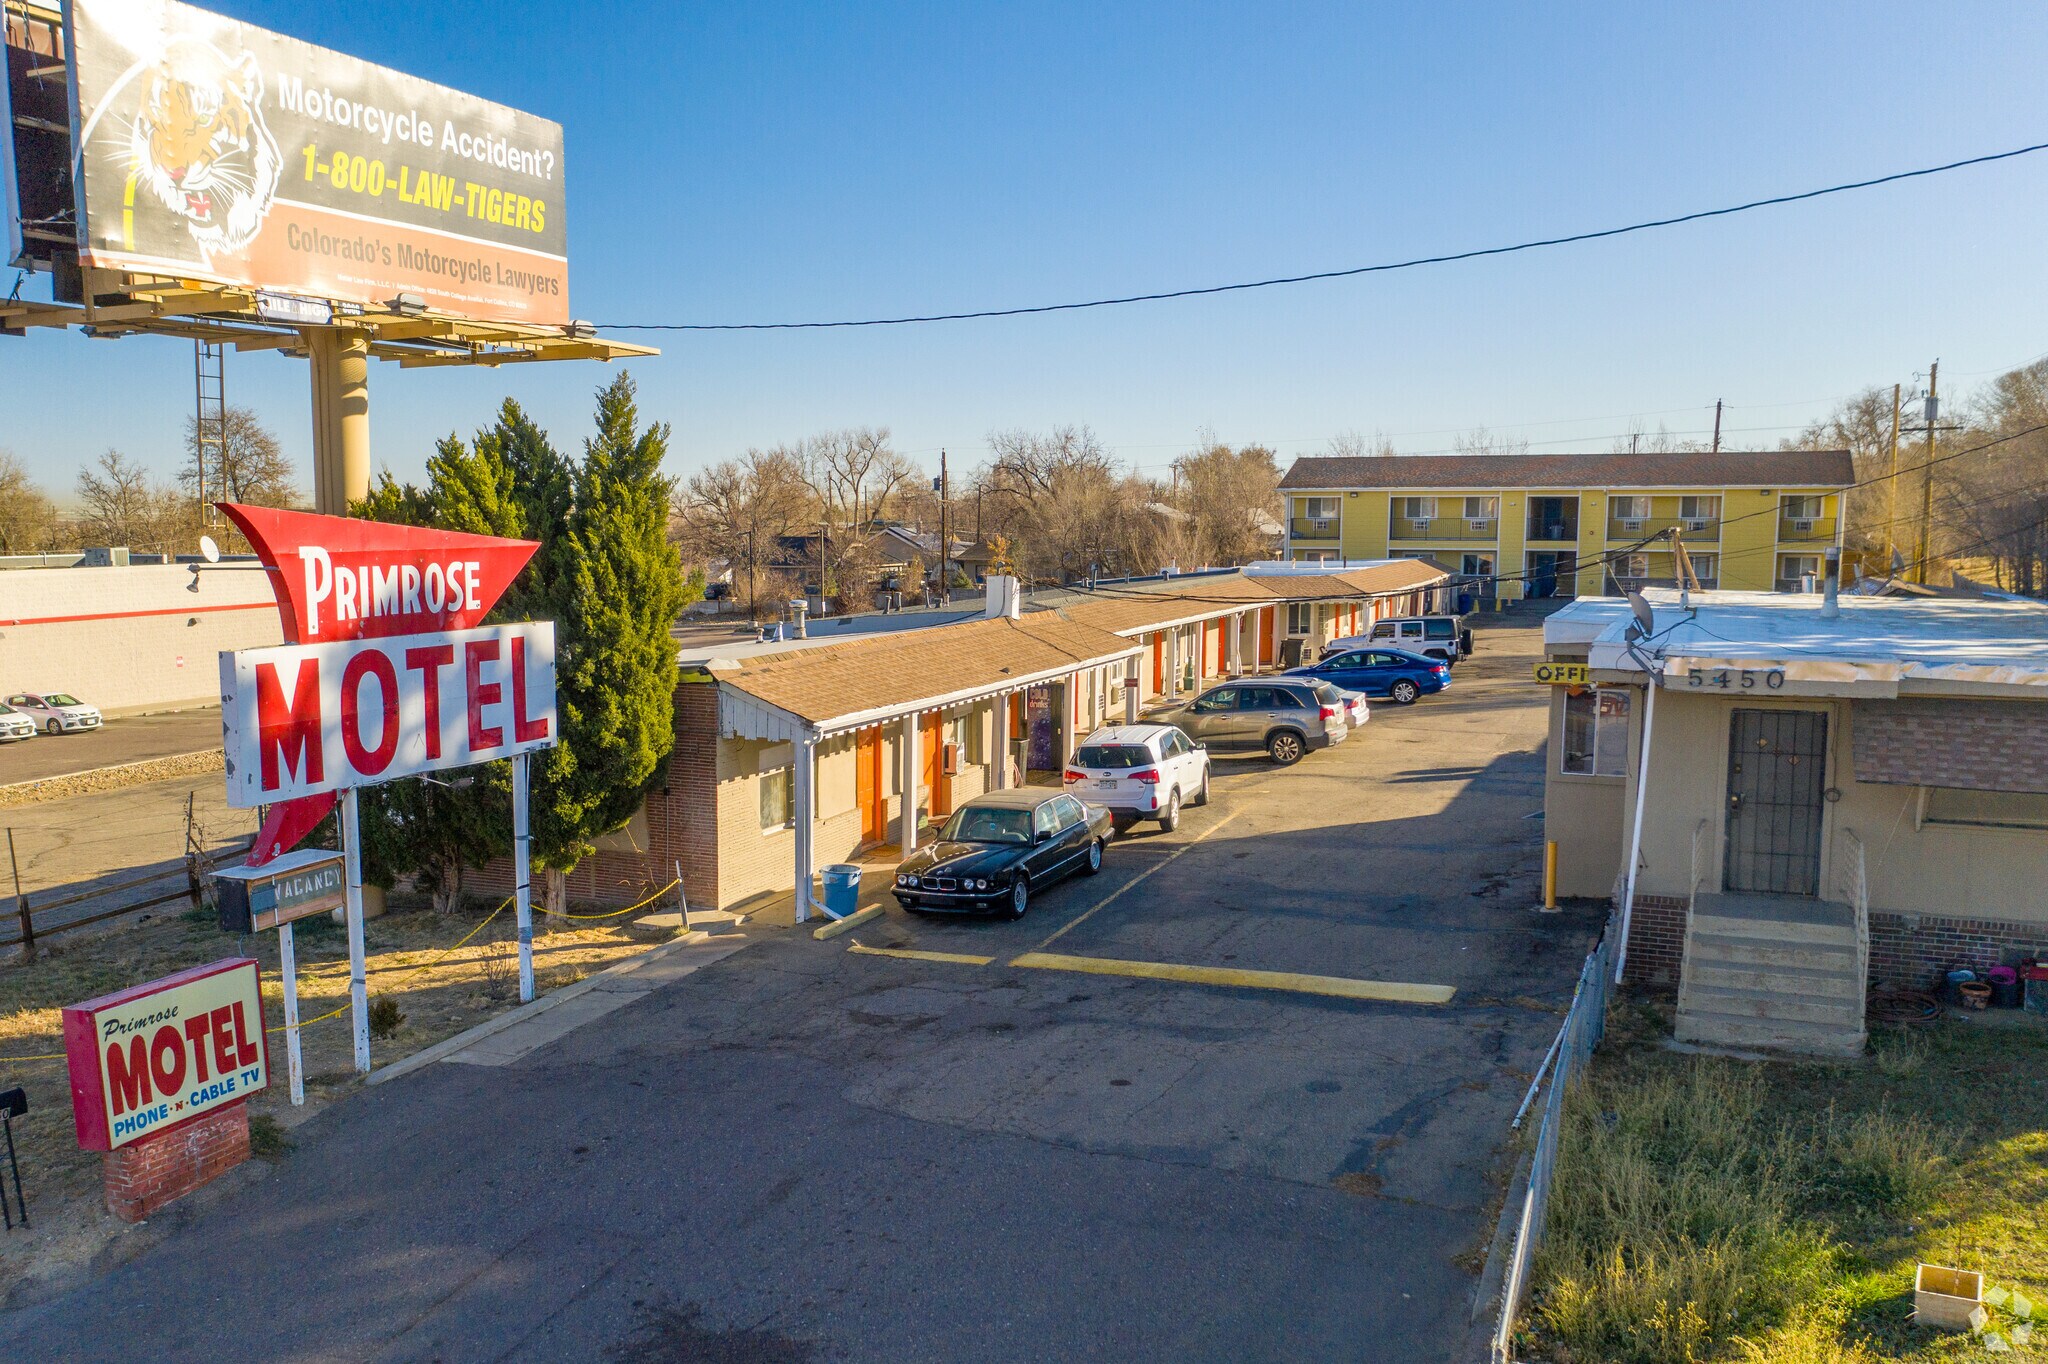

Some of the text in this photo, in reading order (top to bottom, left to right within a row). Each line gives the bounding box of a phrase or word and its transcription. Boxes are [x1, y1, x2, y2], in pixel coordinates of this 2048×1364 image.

[277, 72, 555, 180] Motorcycle Accident?
[302, 143, 546, 233] 1-800-LAW-TIGERS
[287, 222, 559, 296] Colorado's Motorcycle Lawyers
[299, 545, 481, 635] PRIMROSE
[255, 635, 549, 792] MOTEL
[1687, 668, 1784, 689] 5450
[274, 868, 341, 900] VACANCY
[103, 1005, 179, 1042] Primrose
[106, 1000, 259, 1117] MOTEL
[114, 1103, 169, 1138] PHONE
[190, 1077, 236, 1106] CABLE
[241, 1067, 260, 1086] TV
